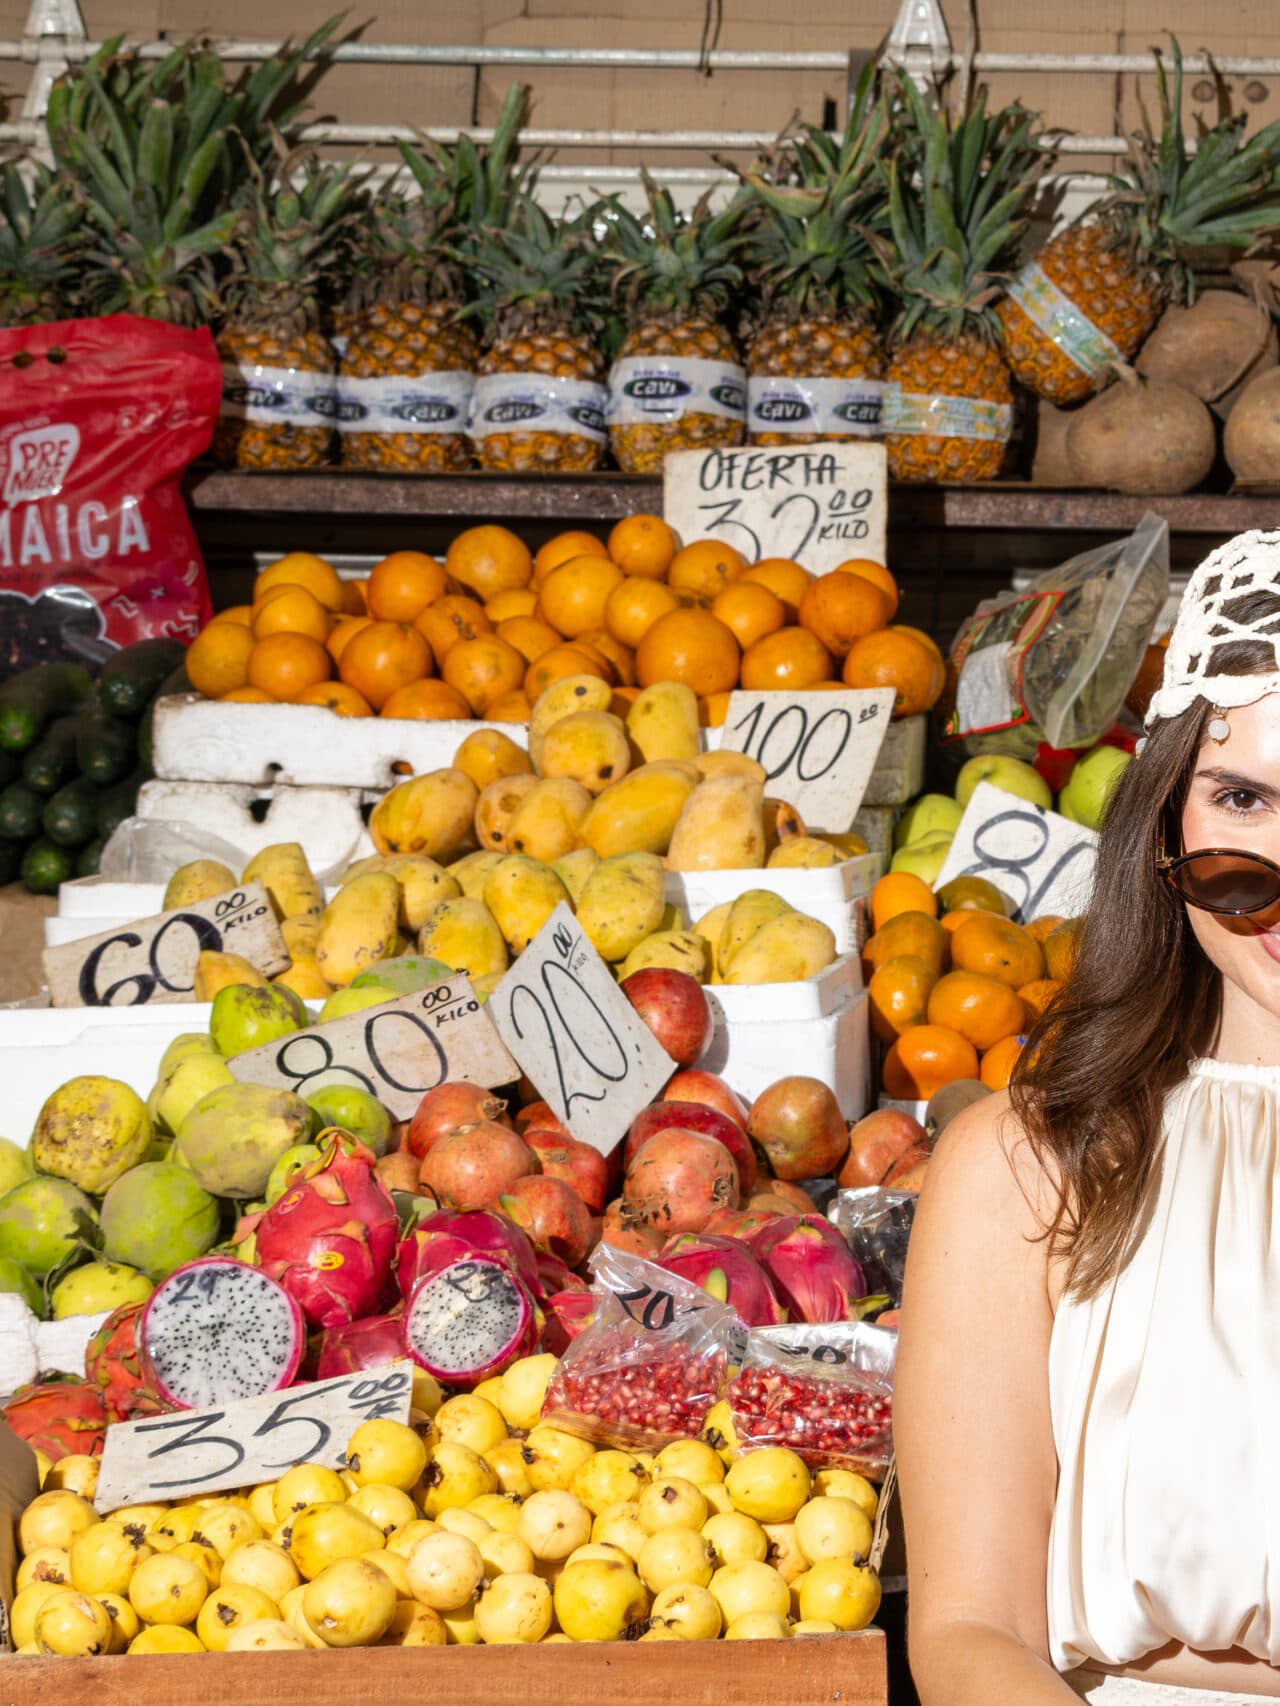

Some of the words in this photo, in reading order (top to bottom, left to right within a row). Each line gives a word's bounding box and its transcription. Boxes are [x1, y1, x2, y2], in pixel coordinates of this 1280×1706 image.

[700, 450, 847, 491] OFERTA
[817, 518, 870, 545] KILO
[733, 701, 853, 782] 100
[223, 905, 269, 935] KILO
[78, 912, 224, 1007] 60
[435, 1000, 481, 1028] KILO
[276, 1009, 449, 1098] 80
[133, 1379, 352, 1489] 35
